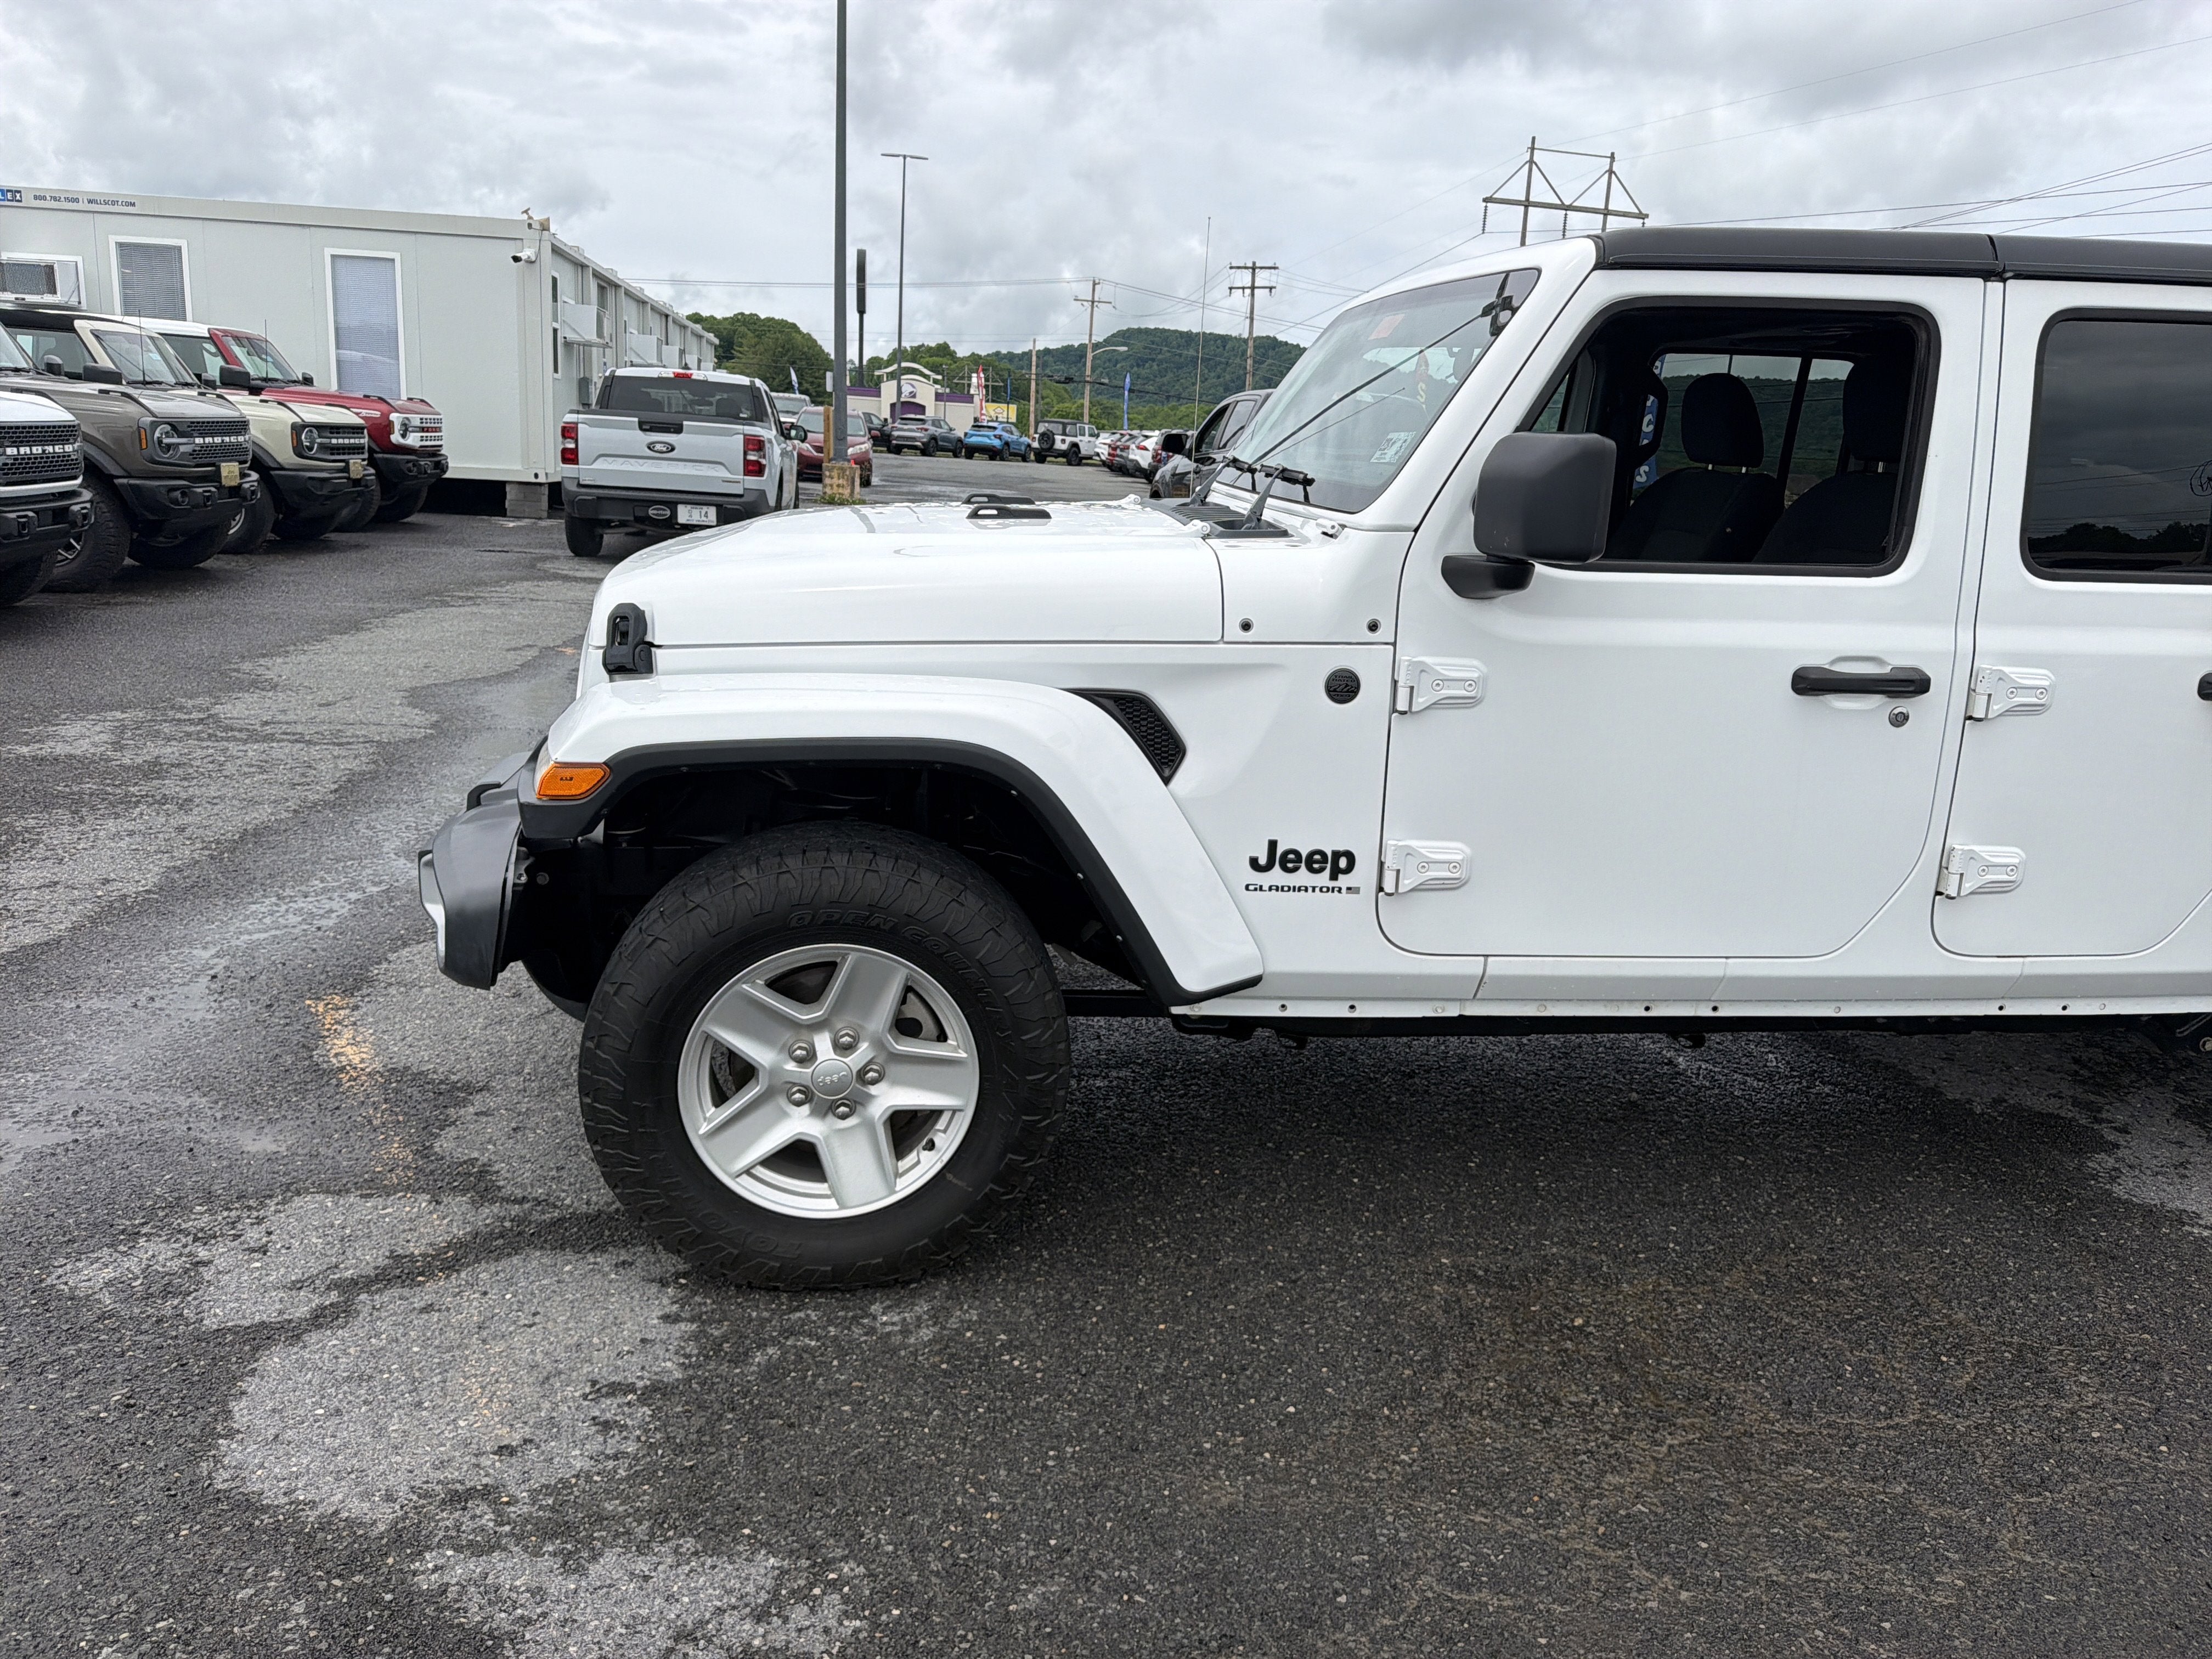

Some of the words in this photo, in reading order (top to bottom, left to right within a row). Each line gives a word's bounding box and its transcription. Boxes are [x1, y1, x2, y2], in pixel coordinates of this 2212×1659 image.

[33, 194, 80, 204] 800.782.1500
[87, 198, 136, 207] WILLSCOT.COM
[194, 436, 244, 444] BRONCO
[5, 444, 73, 455] BRONCO
[604, 459, 720, 472] MAVERICK
[1249, 839, 1356, 881] Jeep
[1244, 883, 1343, 894] GLADIATOR
[788, 909, 898, 930] OPEN
[901, 926, 1015, 1046] COUNTRY
[817, 1071, 847, 1086] Jeep
[698, 1210, 805, 1259] TOYO
